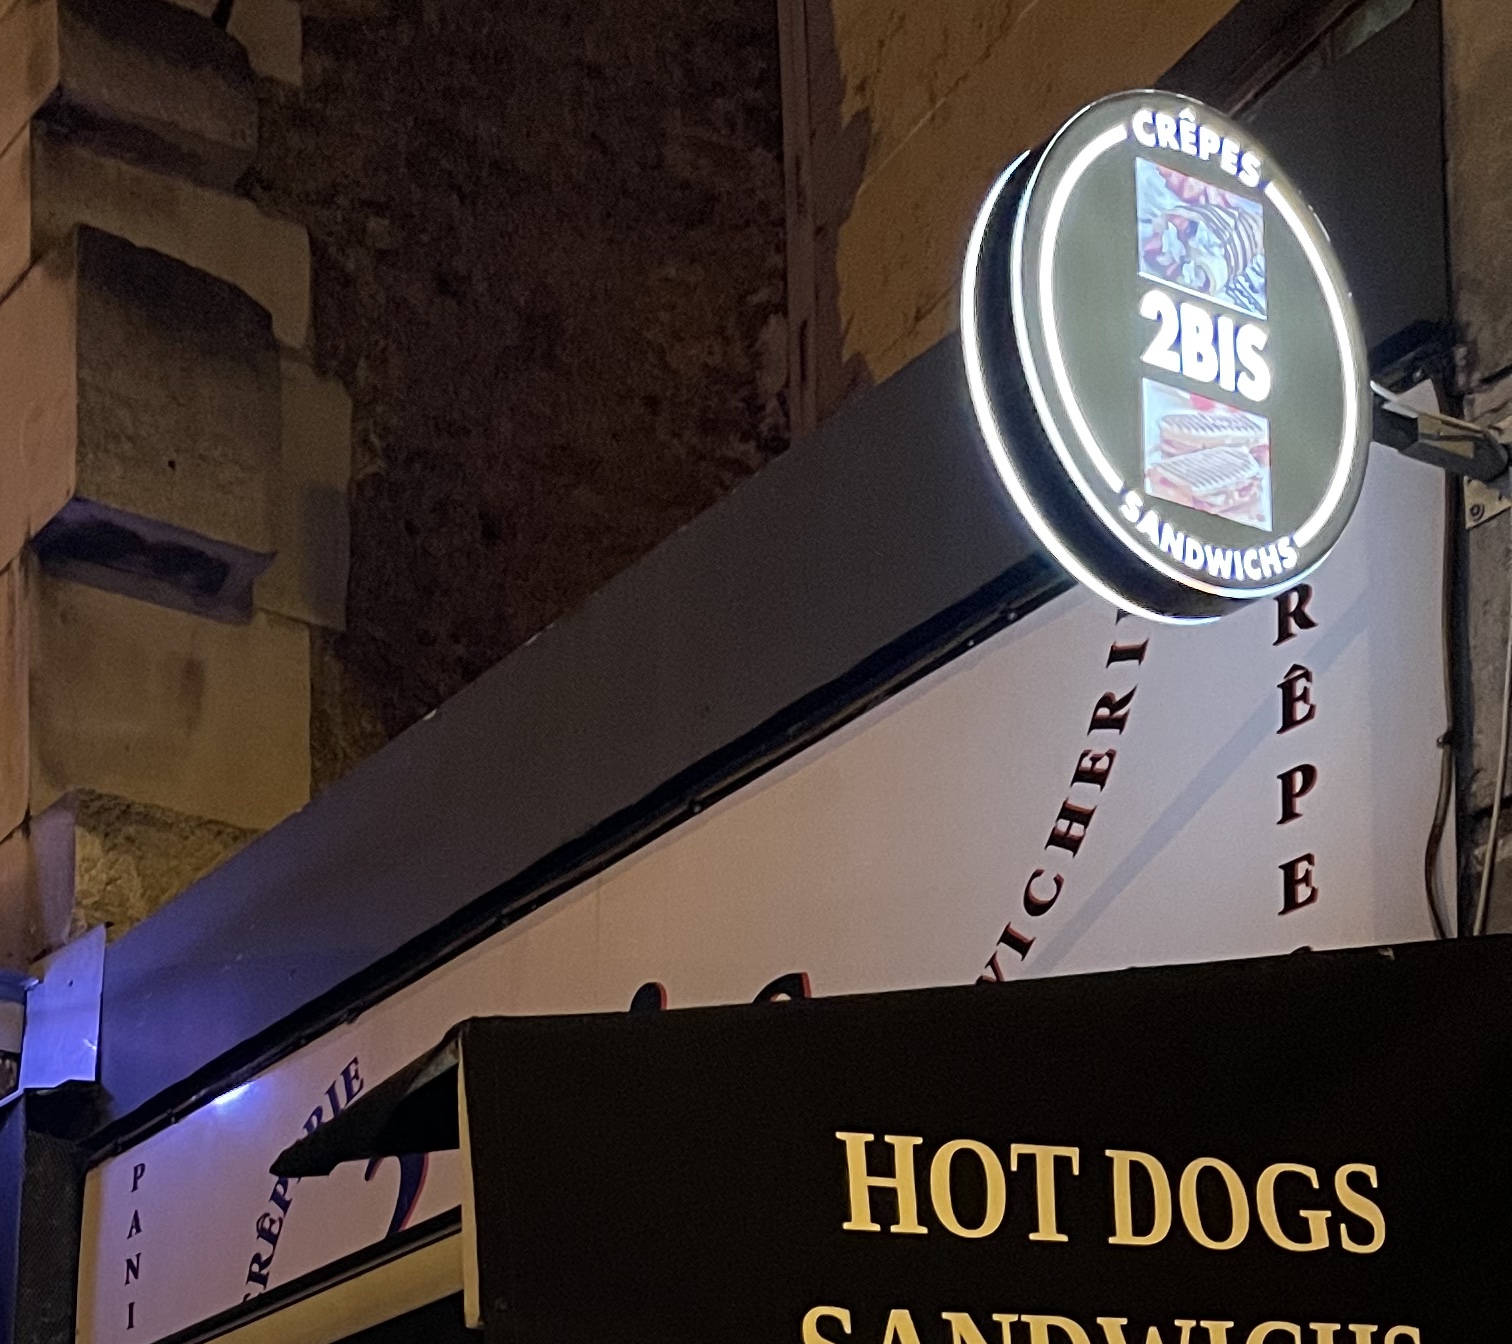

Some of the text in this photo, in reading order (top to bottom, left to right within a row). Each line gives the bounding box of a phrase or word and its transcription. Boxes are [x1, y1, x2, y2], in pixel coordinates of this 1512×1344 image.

[1130, 107, 1263, 189] CRÊPES
[1138, 288, 1274, 403] 2BIS
[1118, 488, 1298, 582] SANDWICHS
[976, 609, 1150, 986] ICHERI
[1273, 583, 1320, 955] RÊPE
[835, 1131, 1387, 1253] HOT DOGS
